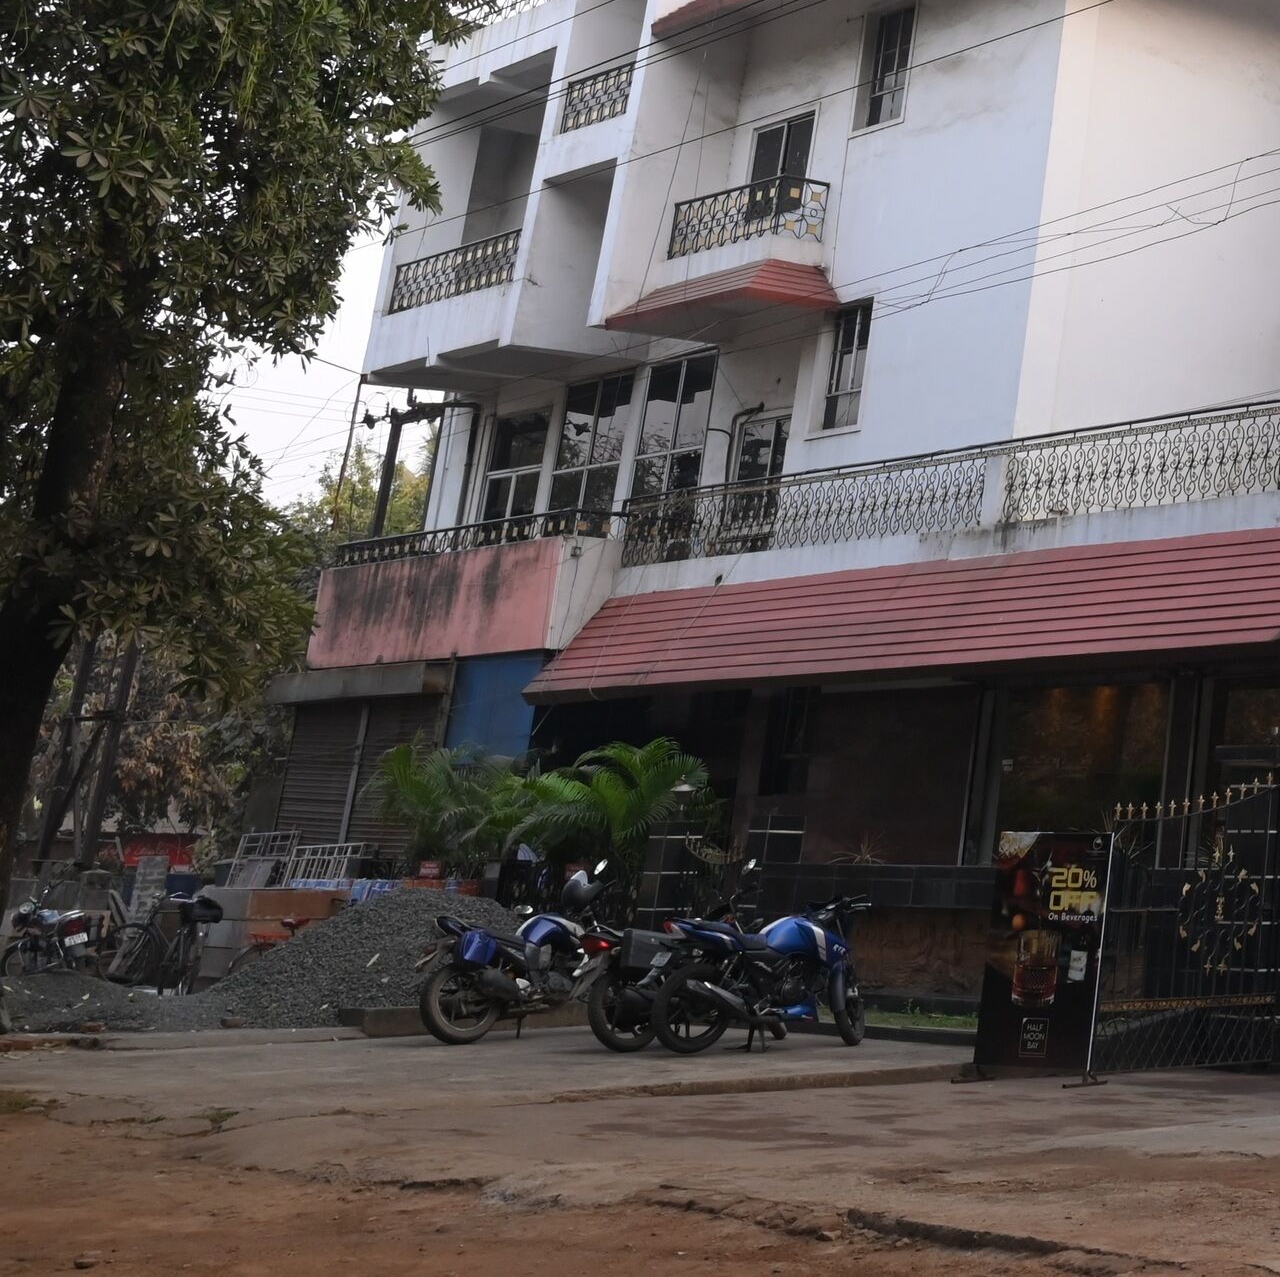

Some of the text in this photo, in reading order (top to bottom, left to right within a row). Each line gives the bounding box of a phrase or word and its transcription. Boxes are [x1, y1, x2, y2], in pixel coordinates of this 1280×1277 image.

[1049, 867, 1097, 888] 20%
[1049, 890, 1098, 911] OFF
[1048, 912, 1098, 924] On Beverages
[1026, 1023, 1044, 1032] HALF
[1023, 1032, 1046, 1041] MOON
[1026, 1041, 1040, 1049] BAY
